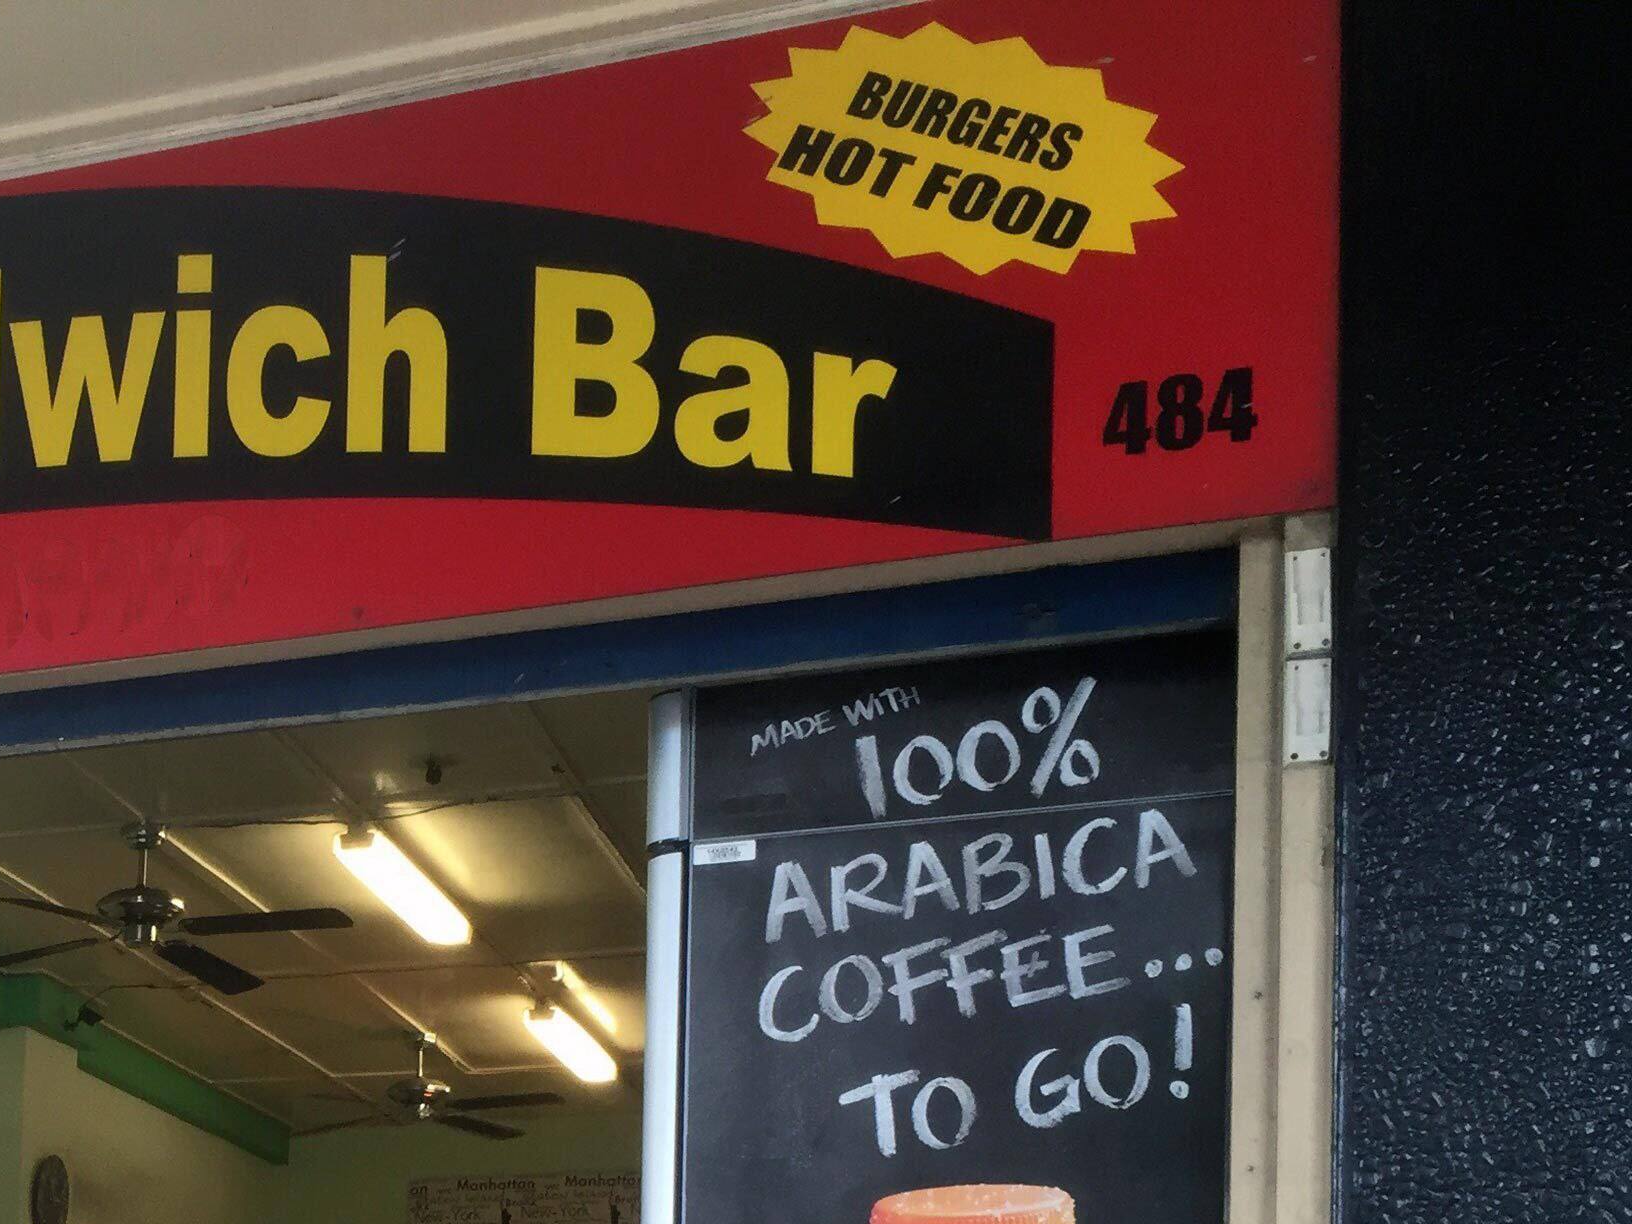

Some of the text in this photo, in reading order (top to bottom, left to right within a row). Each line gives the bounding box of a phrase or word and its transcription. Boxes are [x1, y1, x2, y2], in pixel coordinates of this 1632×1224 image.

[846, 70, 1084, 172] BURGERS
[777, 123, 1093, 250] HOT FOOD
[531, 265, 898, 479] Bar
[1102, 366, 1259, 455] 484
[750, 685, 920, 756] MADE WITH
[855, 676, 1100, 818] 100%
[765, 808, 1197, 943] ARABICA
[839, 1002, 1193, 1157] TO GO!
[457, 1178, 536, 1191] Manhattan
